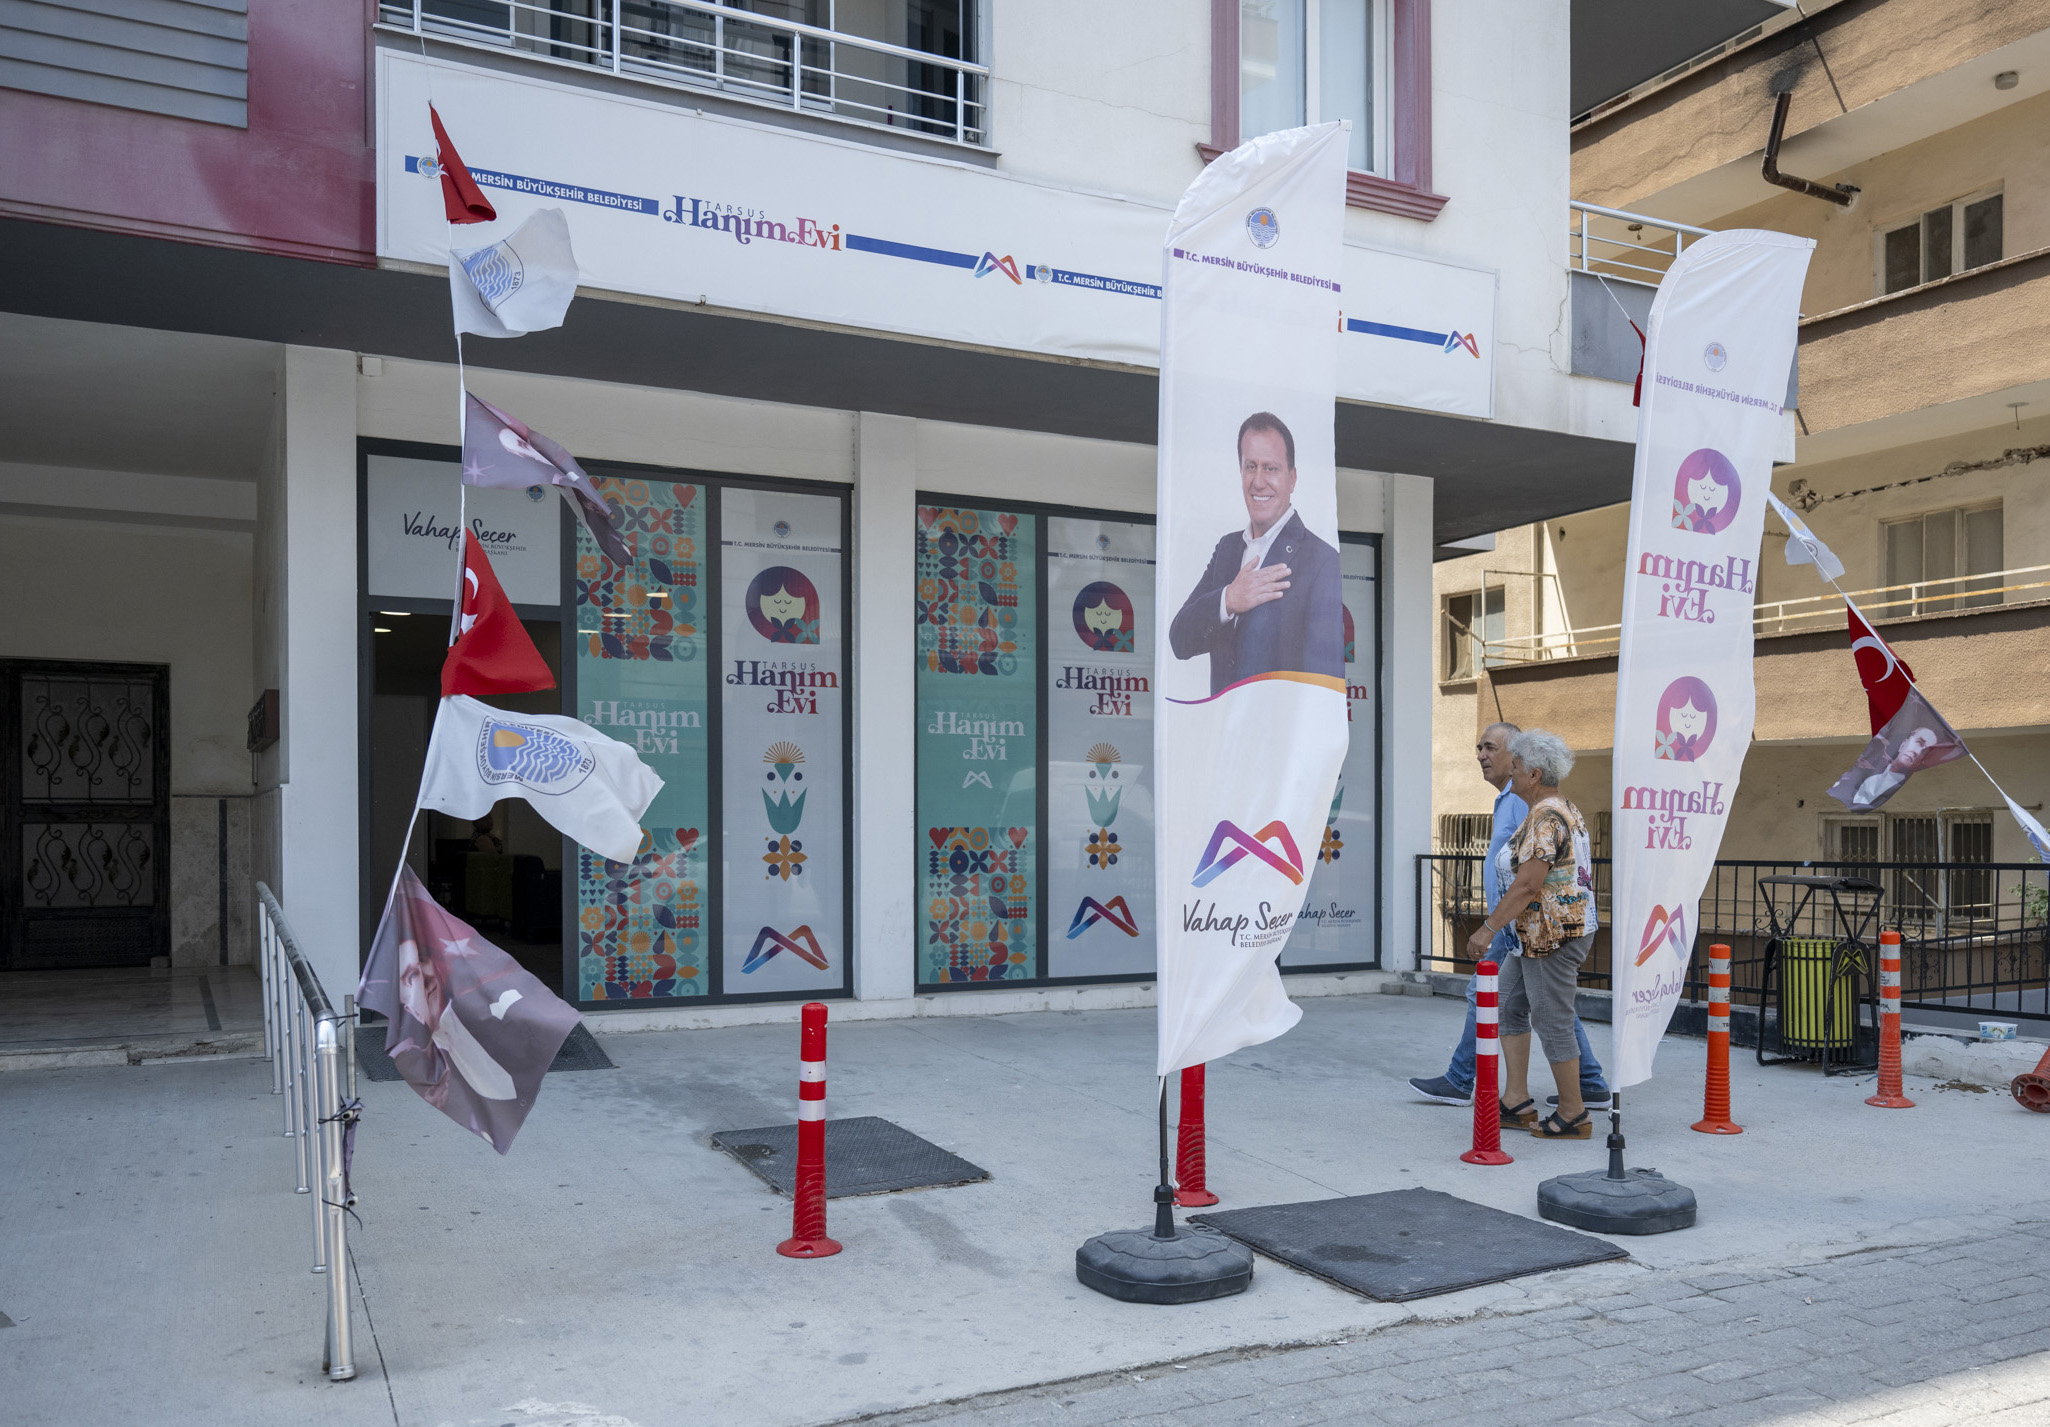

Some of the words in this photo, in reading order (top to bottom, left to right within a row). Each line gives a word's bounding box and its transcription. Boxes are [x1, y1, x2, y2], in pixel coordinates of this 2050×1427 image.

[471, 171, 514, 189] MERSİN
[516, 178, 585, 200] BÜYÜKŞEHİR
[587, 191, 643, 211] BELEDİYESİ
[705, 200, 765, 220] TARSUS
[787, 216, 842, 251] Evi
[511, 271, 521, 290] 1873
[1185, 252, 1200, 263] T.C.
[1201, 255, 1235, 269] MERSİN
[1236, 261, 1288, 280] BÜYÜKŞEHİR
[1290, 272, 1332, 290] BELEDİYESİ
[1057, 272, 1072, 283] T.C.
[1073, 275, 1104, 288] MERSİN
[1105, 280, 1155, 297] BÜYÜKŞEHİR
[403, 511, 461, 550] Vahap
[472, 518, 517, 543] Seçer
[726, 660, 840, 695] Hanım
[762, 661, 816, 671] TARSUS
[1086, 667, 1131, 676] TARSUS
[1056, 666, 1150, 698] Hanım
[766, 688, 819, 714] Evi
[1089, 693, 1132, 716] Evi
[583, 700, 702, 735] Hanım
[928, 711, 1026, 743] Hanım
[629, 728, 680, 754] Evi
[962, 737, 1007, 760] Evi
[578, 757, 593, 774] 1873
[1183, 899, 1249, 946] Vahap
